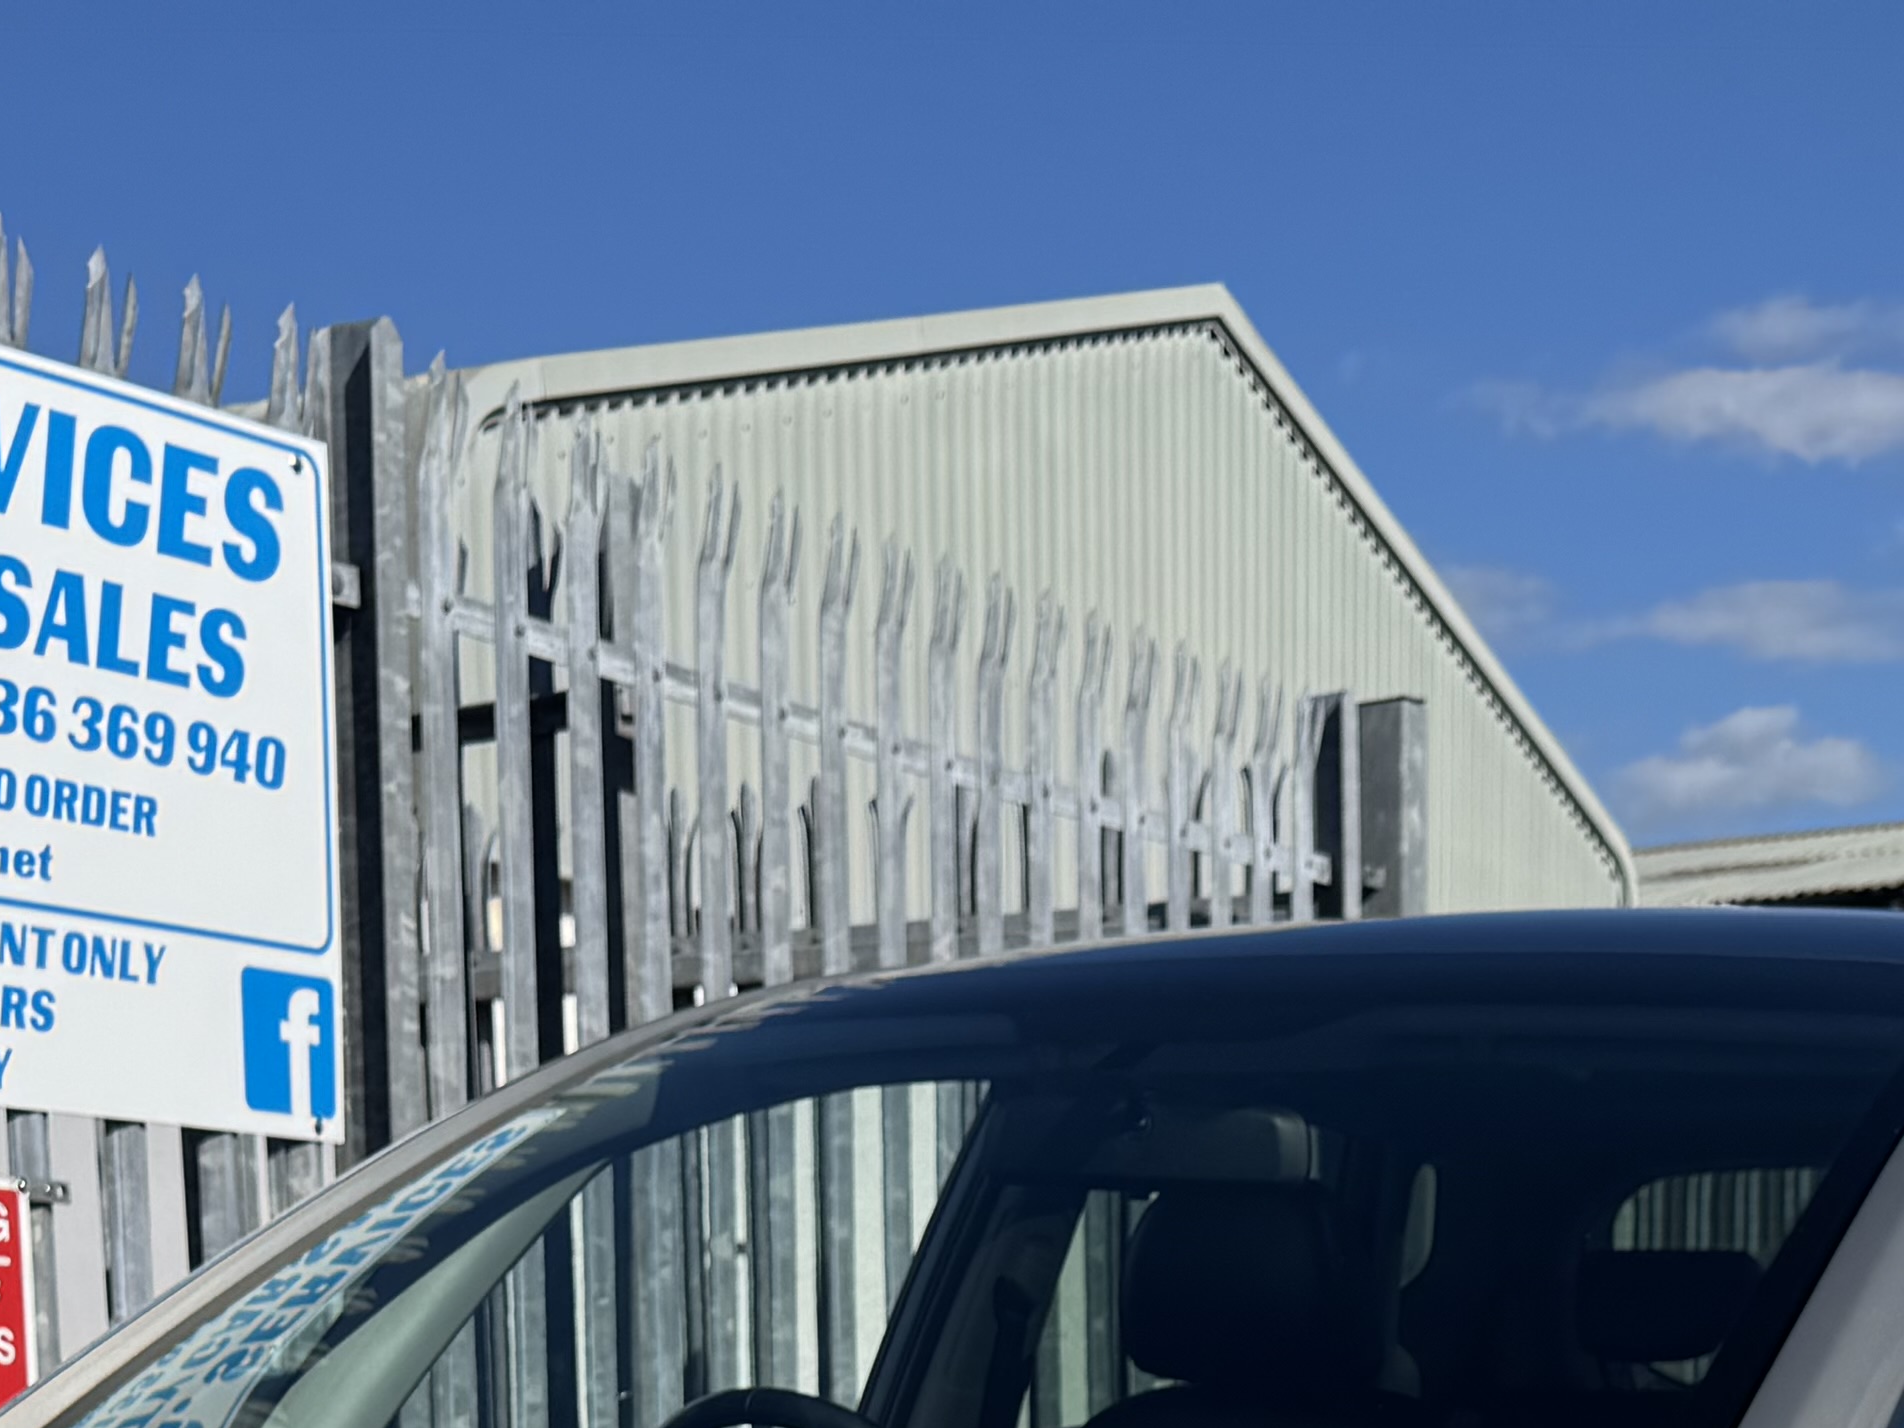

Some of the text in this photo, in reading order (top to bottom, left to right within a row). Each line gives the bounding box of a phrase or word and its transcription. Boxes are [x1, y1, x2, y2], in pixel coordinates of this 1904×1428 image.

[68, 696, 176, 767] 369
[187, 721, 286, 791] 940
[24, 774, 158, 837] ORDER
[62, 931, 166, 985] ONLY
